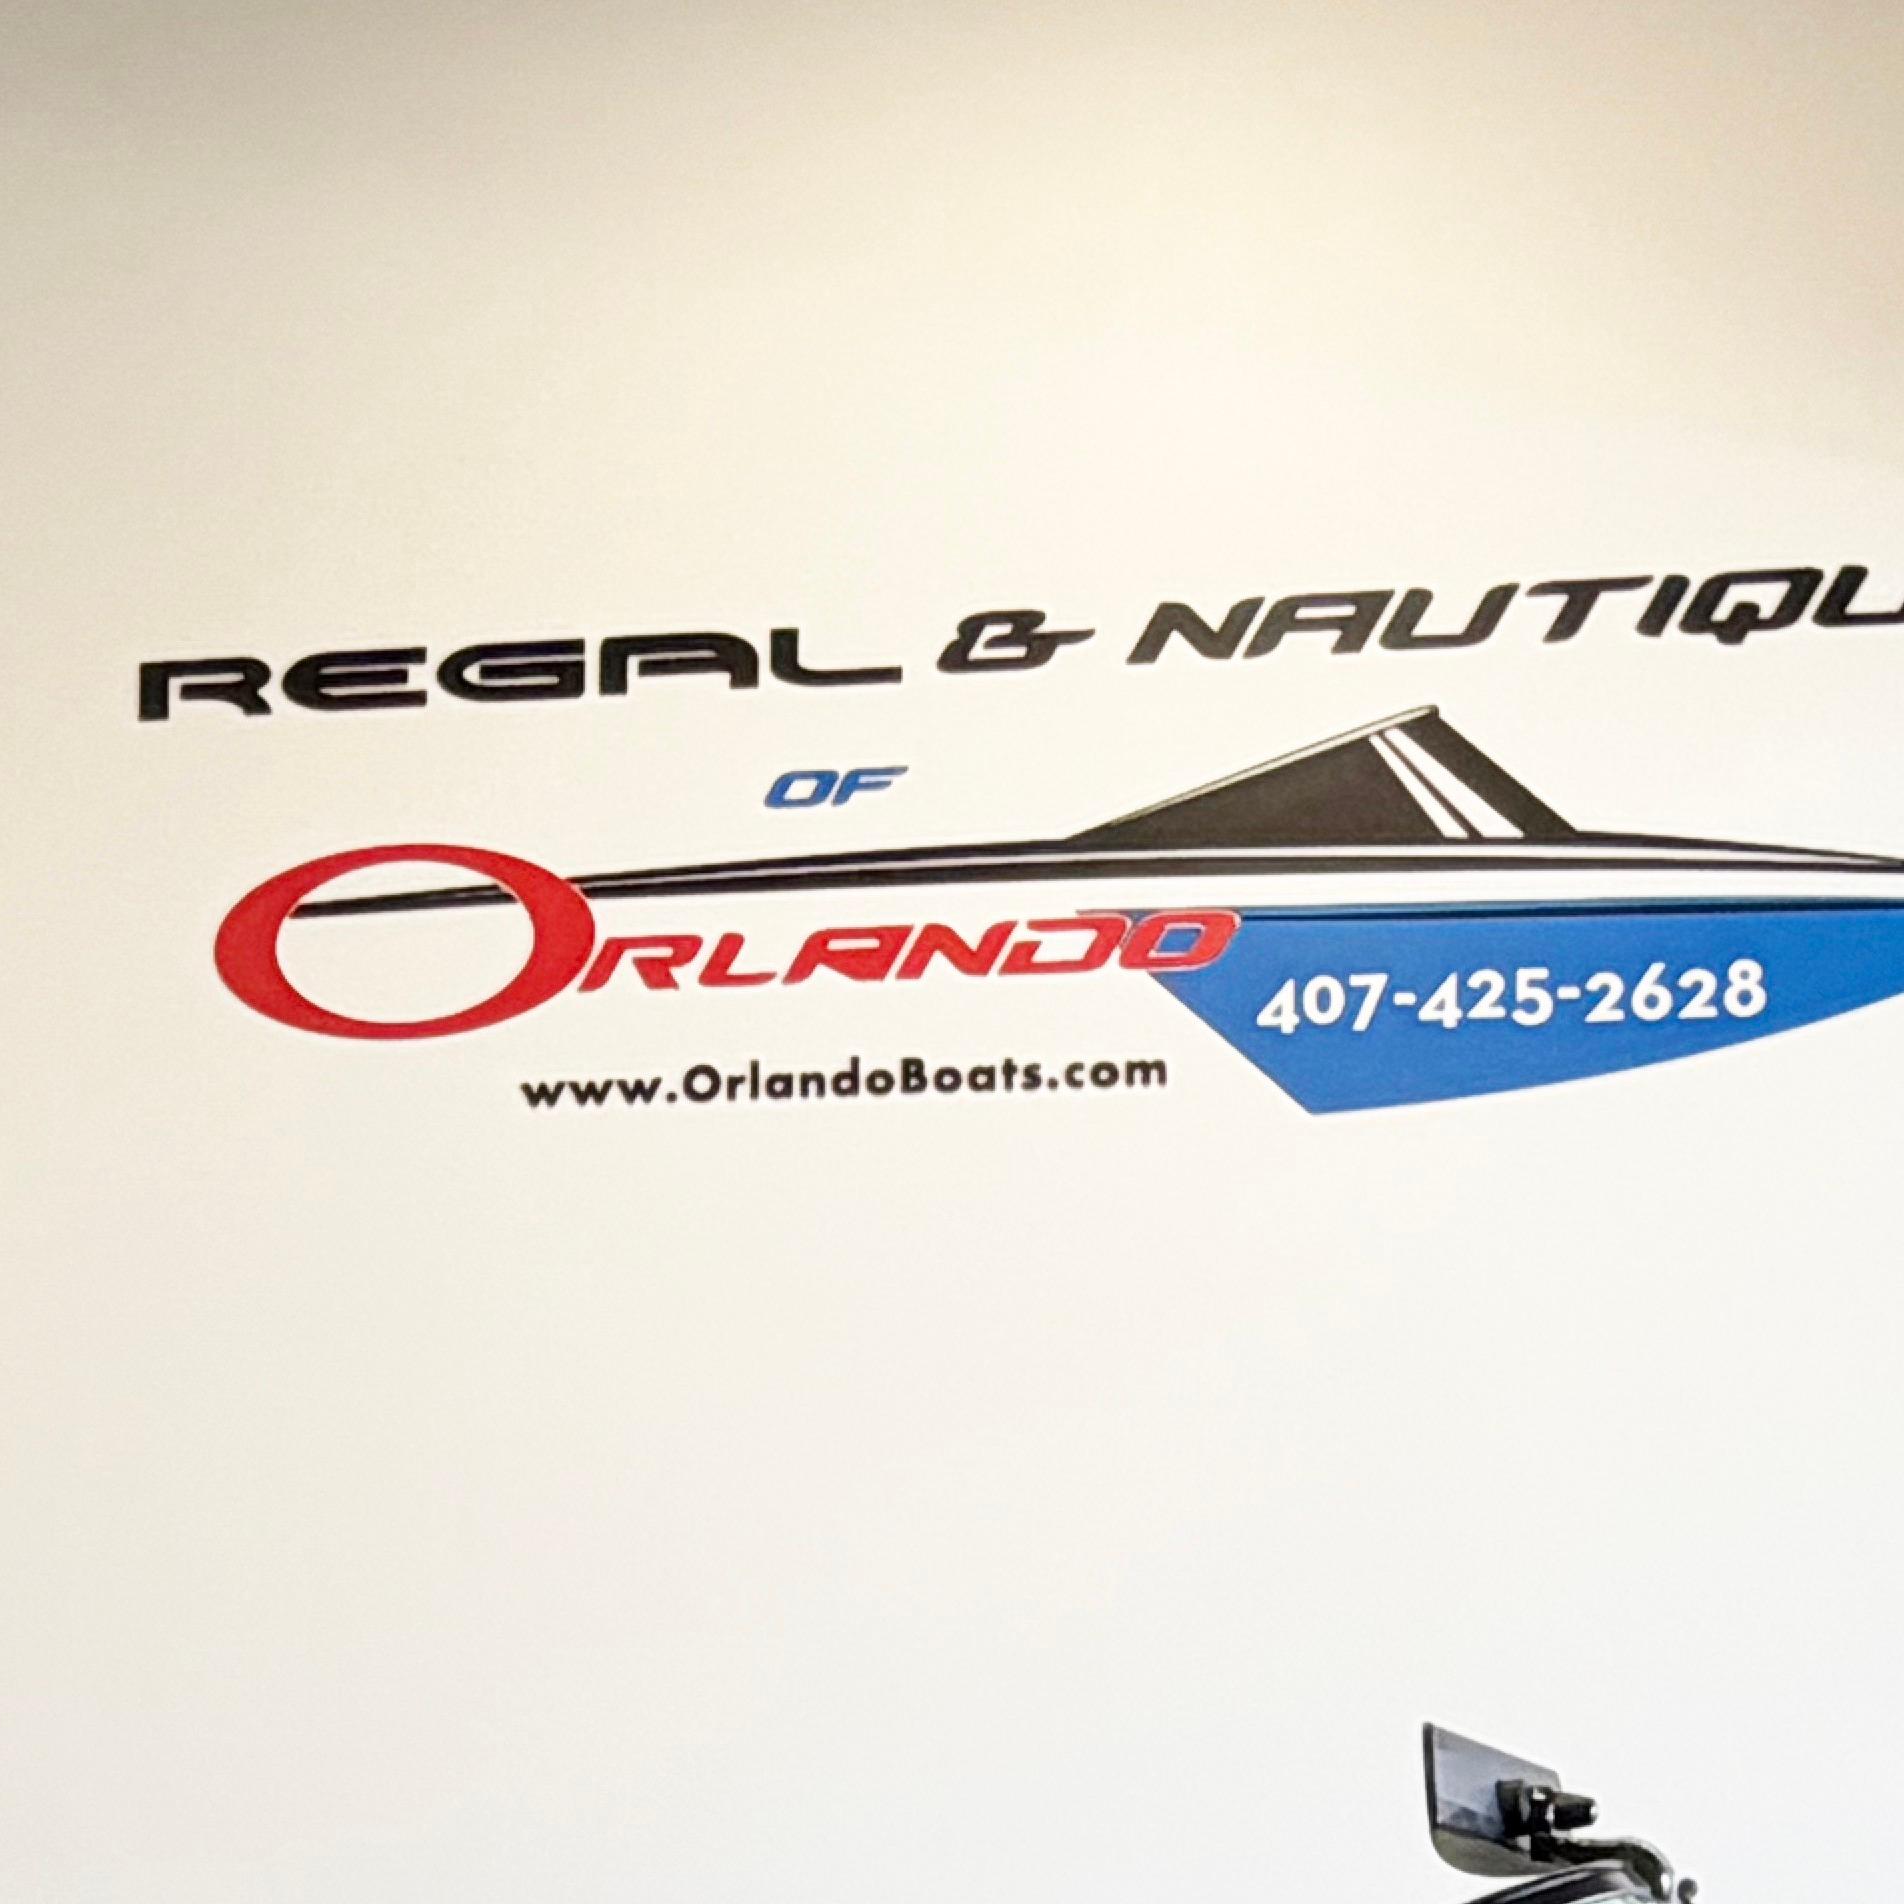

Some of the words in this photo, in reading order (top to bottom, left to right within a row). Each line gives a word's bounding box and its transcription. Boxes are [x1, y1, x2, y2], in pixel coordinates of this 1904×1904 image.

[138, 628, 902, 722] REGAL
[936, 610, 1094, 674] &
[765, 767, 908, 809] OF
[214, 843, 1243, 1041] ORLANDO
[1256, 957, 1769, 1035] 407-425-2628
[519, 1055, 1167, 1109] www.OrlandoBoats.com
